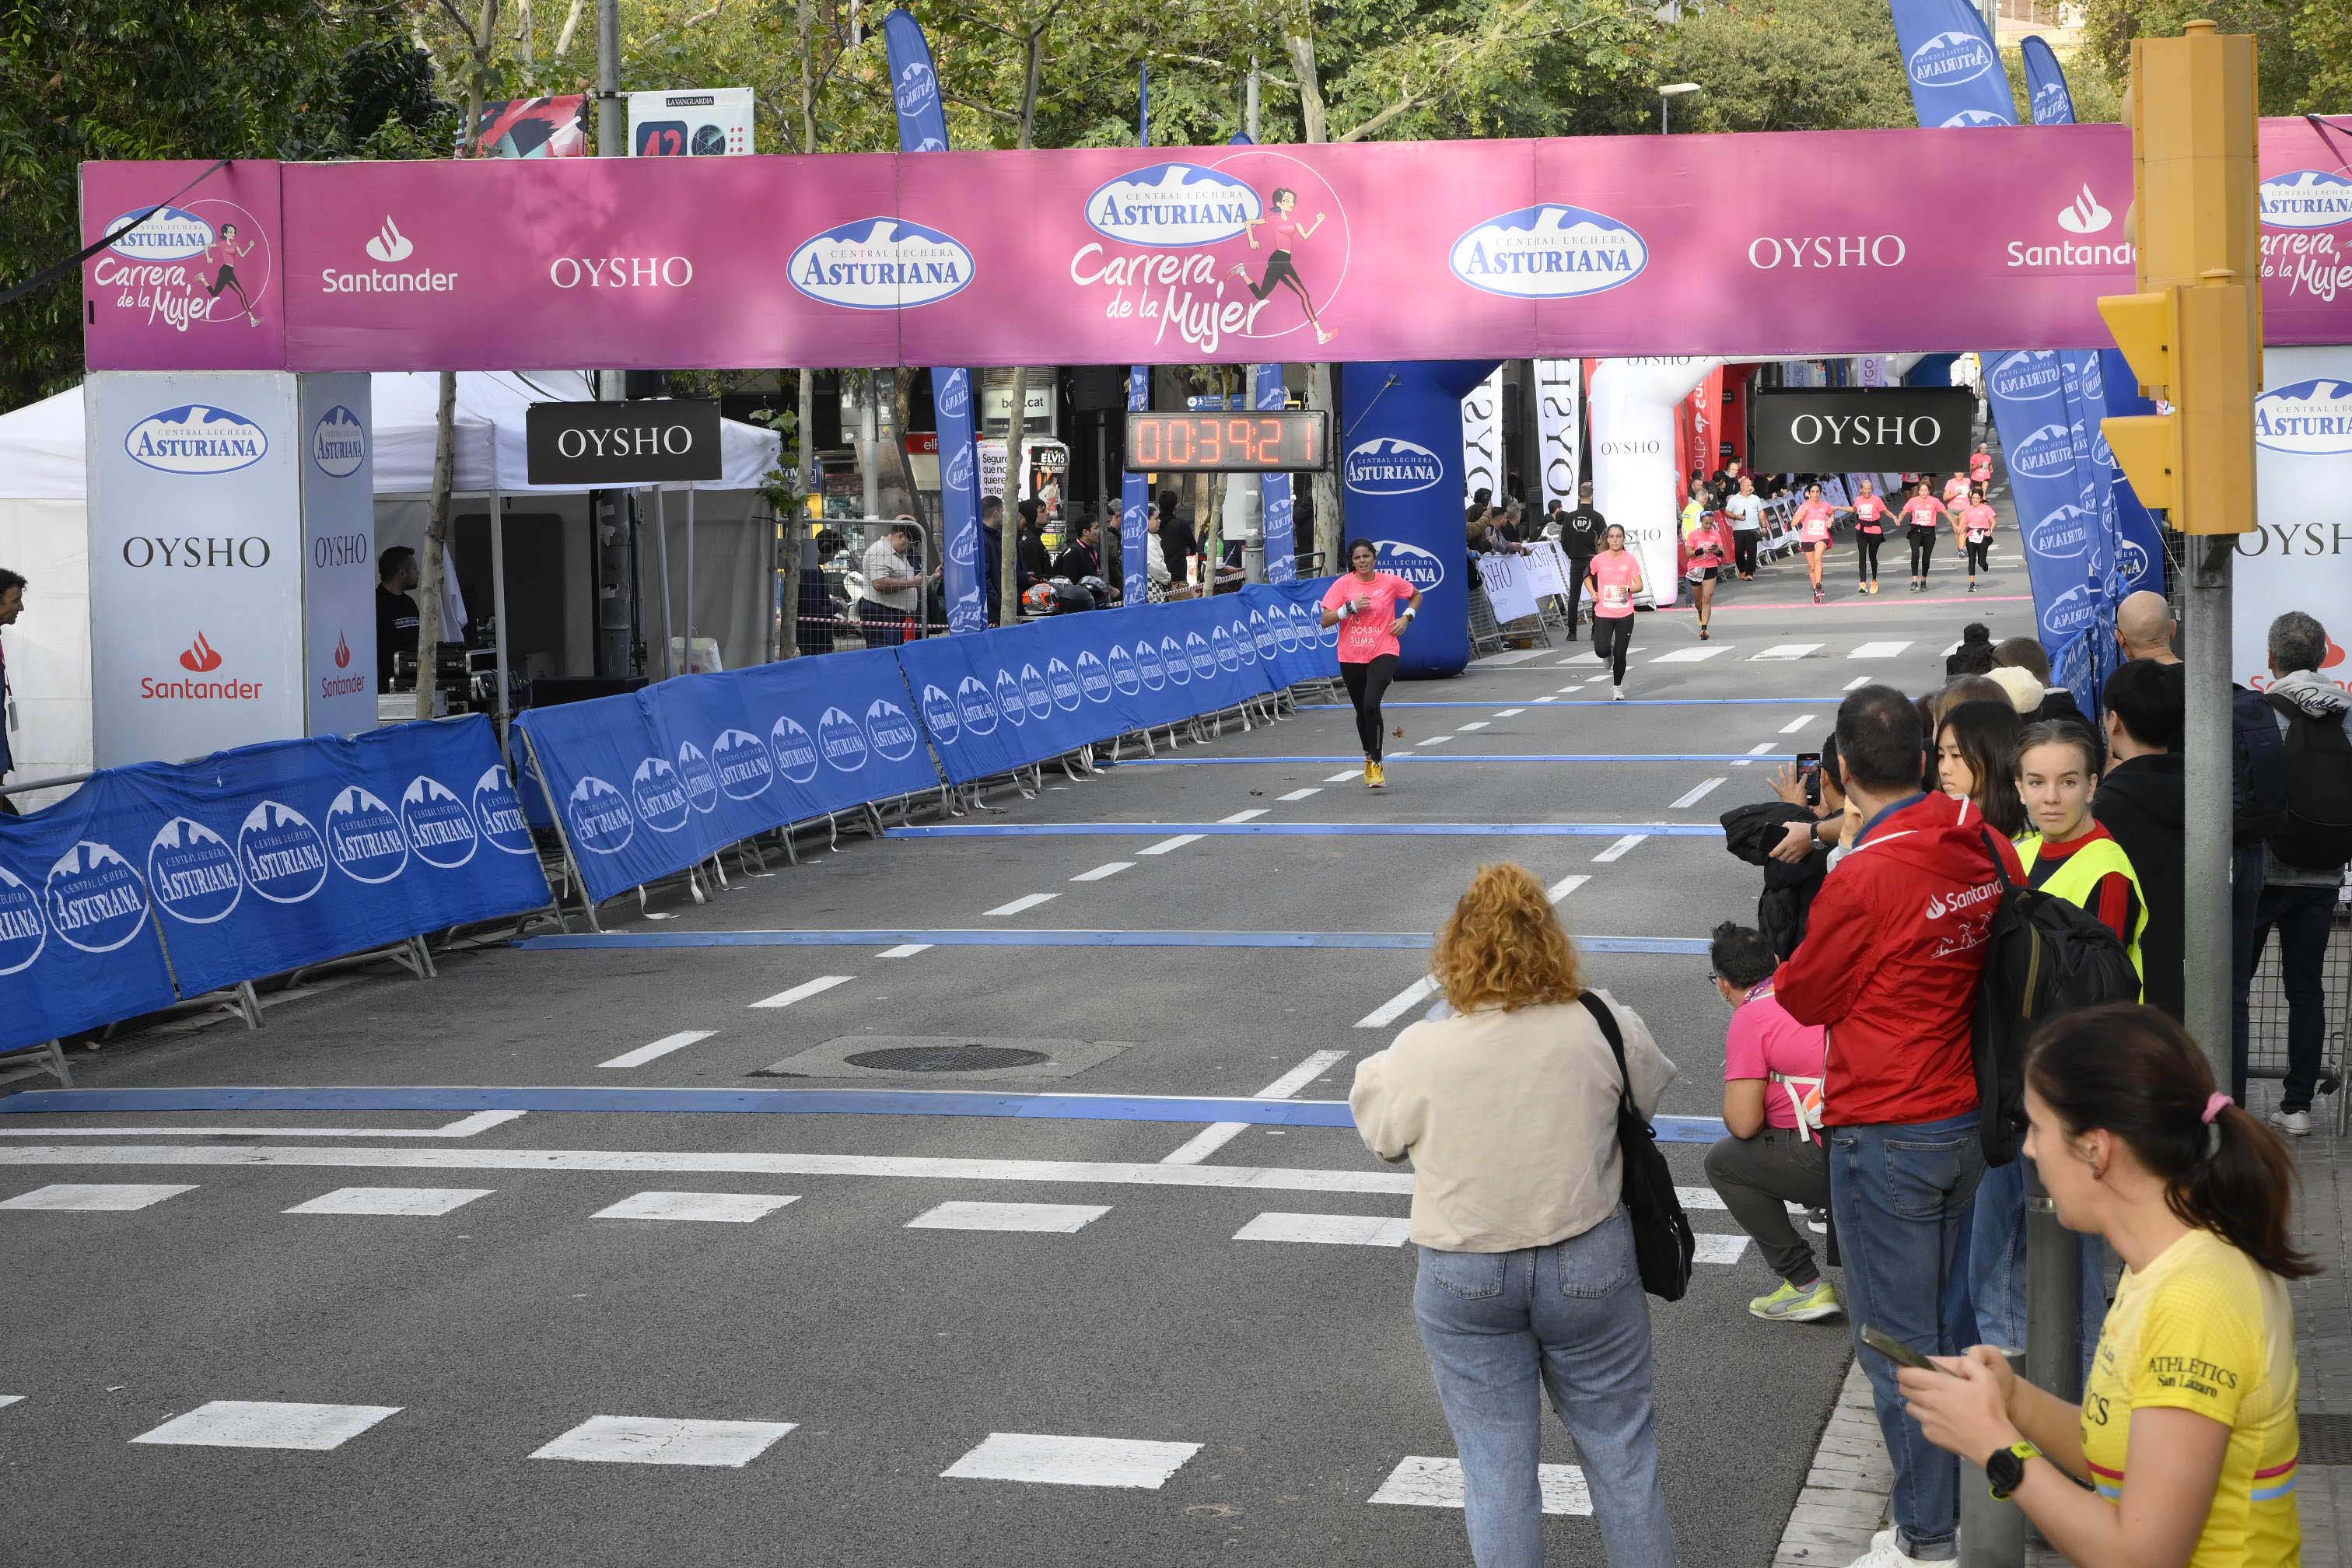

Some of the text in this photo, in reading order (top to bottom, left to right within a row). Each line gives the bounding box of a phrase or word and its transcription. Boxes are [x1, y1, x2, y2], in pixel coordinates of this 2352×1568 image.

[1098, 194, 1248, 226] ASTURIANA
[1125, 190, 1244, 201] CENTRAL LECHERA
[831, 248, 954, 258] CENTRAL LECHERA
[1465, 235, 1633, 275] ASTURIANA
[1496, 236, 1626, 247] CENTRAL LECHERA
[1748, 234, 1906, 269] OYSHO
[2007, 242, 2137, 267] Santand
[2260, 233, 2335, 256] arrera
[94, 257, 187, 289] Carrera
[322, 268, 458, 292] Santander
[550, 257, 694, 289] OYSHO
[801, 250, 961, 286] ASTURIANA
[1070, 243, 1216, 286] Carrera
[2279, 257, 2293, 278] la
[2289, 252, 2352, 302] Muje
[117, 282, 222, 331] de la Mujer
[1106, 280, 1270, 354] de la Mujer
[2256, 408, 2352, 436] ASTURI
[2277, 405, 2329, 414] CENTRAL
[136, 430, 257, 457] ASTURIANA
[558, 425, 692, 458] OYSHO
[1790, 414, 1941, 446] OYSHO
[317, 434, 362, 460] ASTURIANA
[1041, 453, 1065, 464] ELVIS
[1601, 439, 1660, 456] OYSHO
[983, 467, 996, 476] que
[1347, 461, 1436, 482] ASTURIANA
[123, 537, 271, 568] OYSHO
[314, 533, 367, 569] OYSHO
[2233, 522, 2352, 557] OYSH
[1350, 636, 1375, 645] SUMA
[141, 677, 263, 700] Santander
[321, 674, 366, 698] Santander
[254, 829, 313, 849] CENTRAL LECHERA
[333, 825, 405, 863] ASTURIANA
[408, 813, 475, 849] ASTURIANA
[166, 847, 226, 866] CENTRAL LECHERA
[247, 842, 324, 884] ASTURIANA
[158, 861, 239, 903] ASTURIANA
[1945, 878, 2004, 912] Santand
[2149, 1356, 2238, 1389] ATHLETICS
